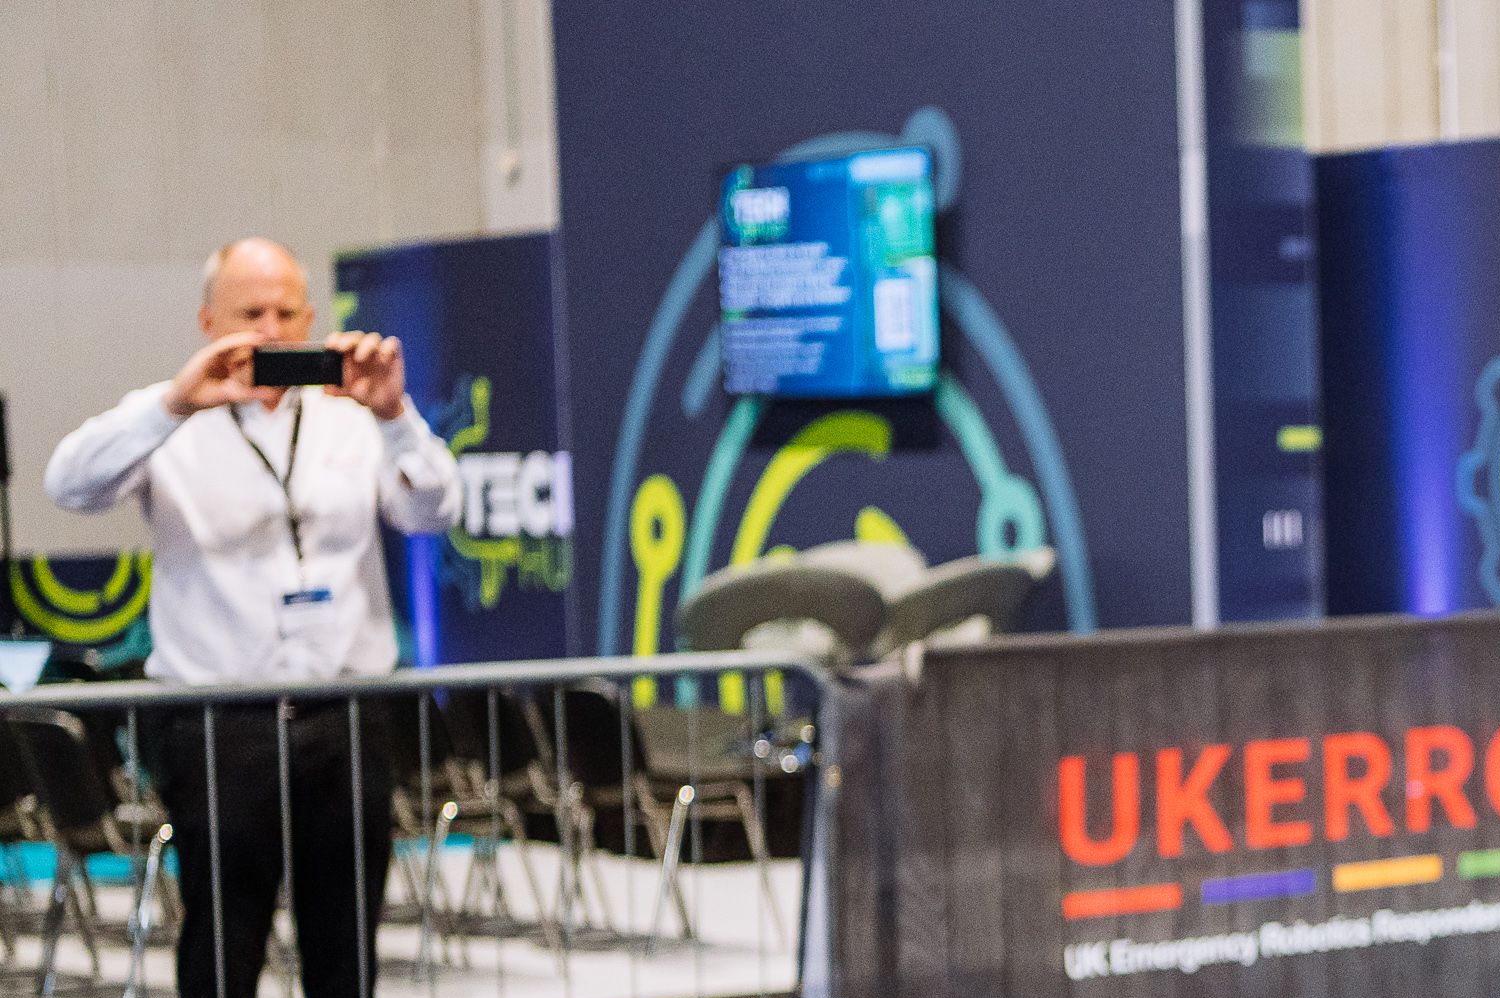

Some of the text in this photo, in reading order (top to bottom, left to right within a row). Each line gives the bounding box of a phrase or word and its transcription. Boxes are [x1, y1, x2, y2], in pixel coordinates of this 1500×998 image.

[1064, 940, 1110, 980] UK
[1109, 929, 1259, 975] Emergency
[1259, 918, 1371, 958] Robotics
